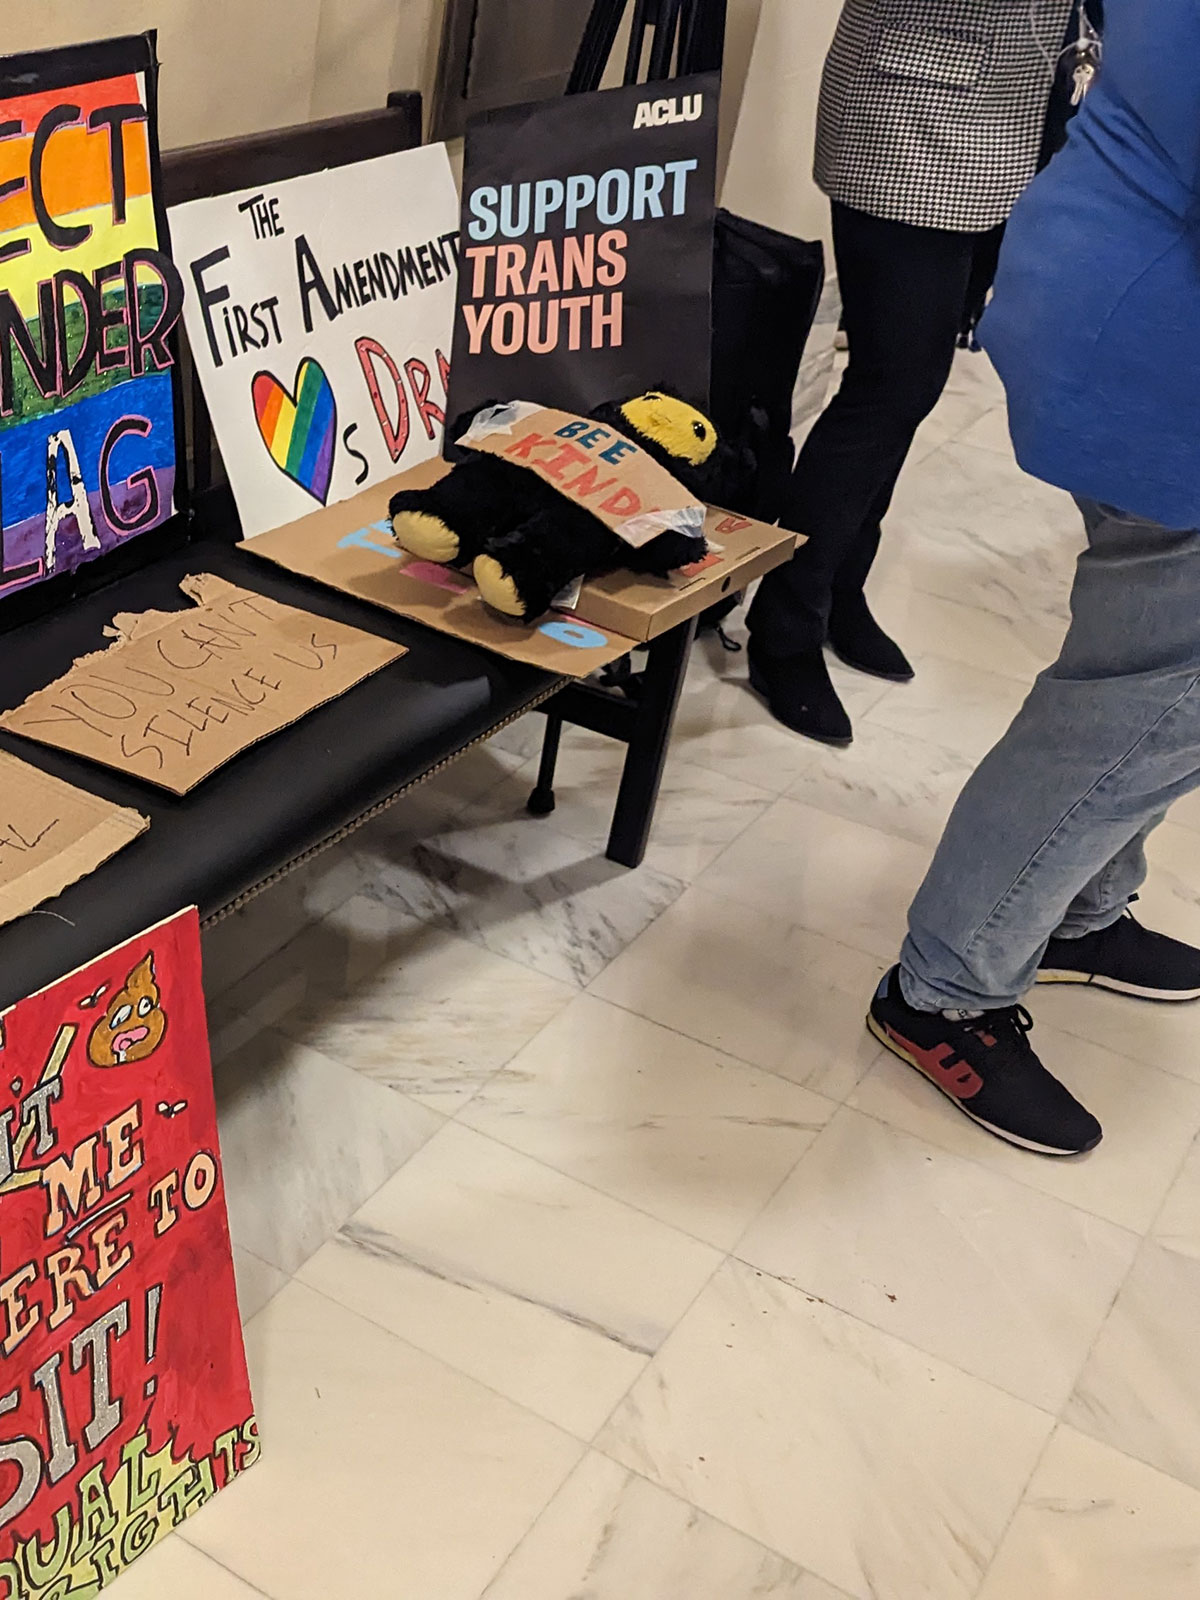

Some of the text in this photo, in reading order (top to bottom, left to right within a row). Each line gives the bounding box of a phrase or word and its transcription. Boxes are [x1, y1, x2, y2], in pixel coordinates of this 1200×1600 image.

[633, 93, 703, 130] ACLU
[238, 193, 285, 240] THE
[467, 158, 698, 241] SUPPORT
[294, 231, 461, 333] AMENDMENT
[465, 229, 628, 298] TRANS
[462, 291, 623, 355] YOUTH
[504, 433, 642, 517] KIND
[554, 421, 638, 465] BEE
[23, 666, 175, 738] YOU
[120, 633, 337, 769] SILENCE US
[41, 1102, 145, 1238] ME
[147, 1149, 219, 1238] TO
